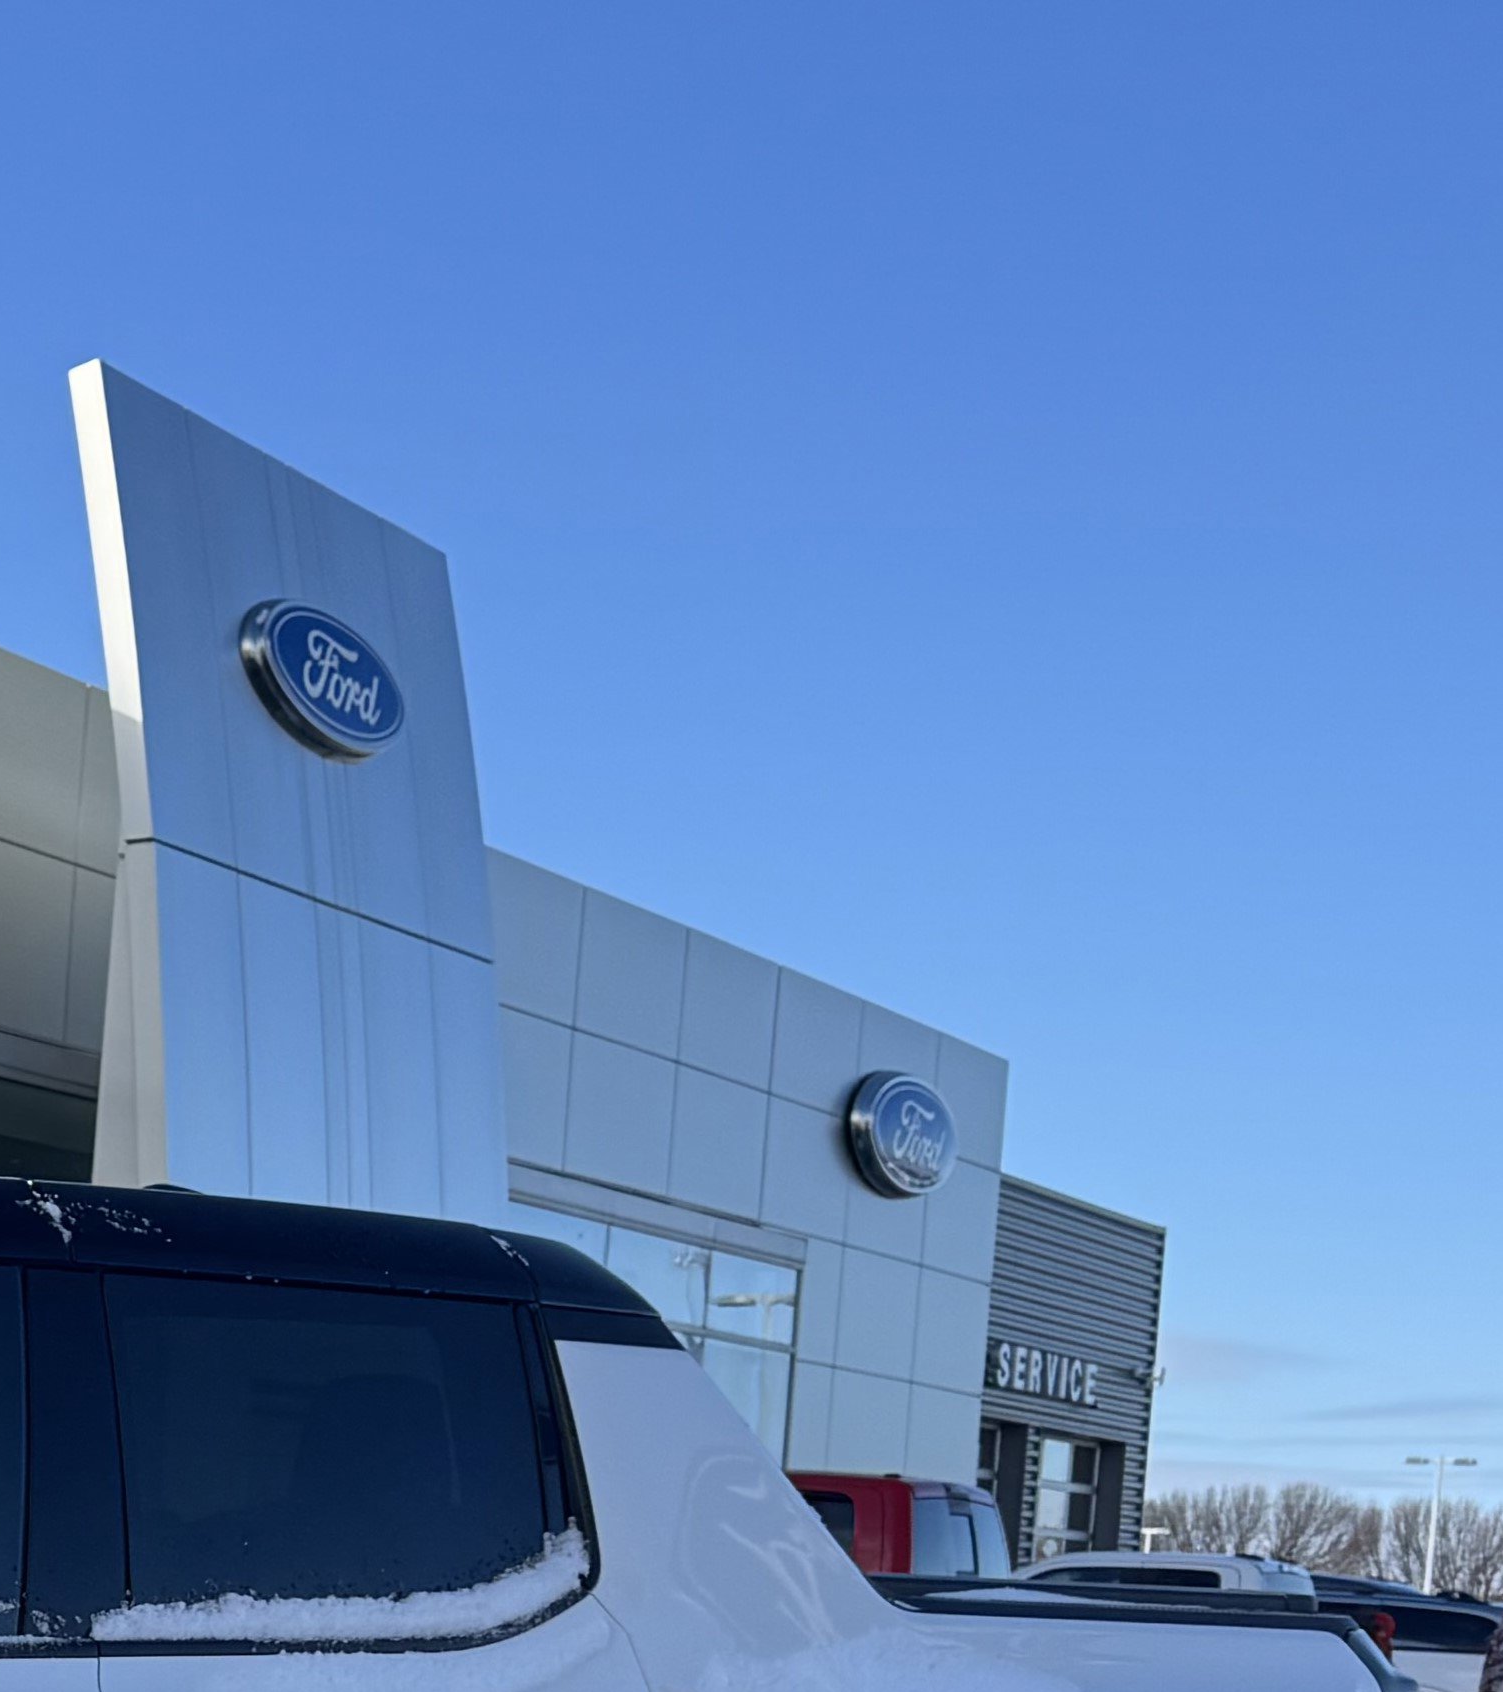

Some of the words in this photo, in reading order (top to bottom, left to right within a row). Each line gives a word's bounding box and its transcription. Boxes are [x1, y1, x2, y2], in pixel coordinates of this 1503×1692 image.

[303, 629, 382, 727] Ford
[893, 1099, 946, 1172] Ford
[996, 1343, 1098, 1405] SERVICE
